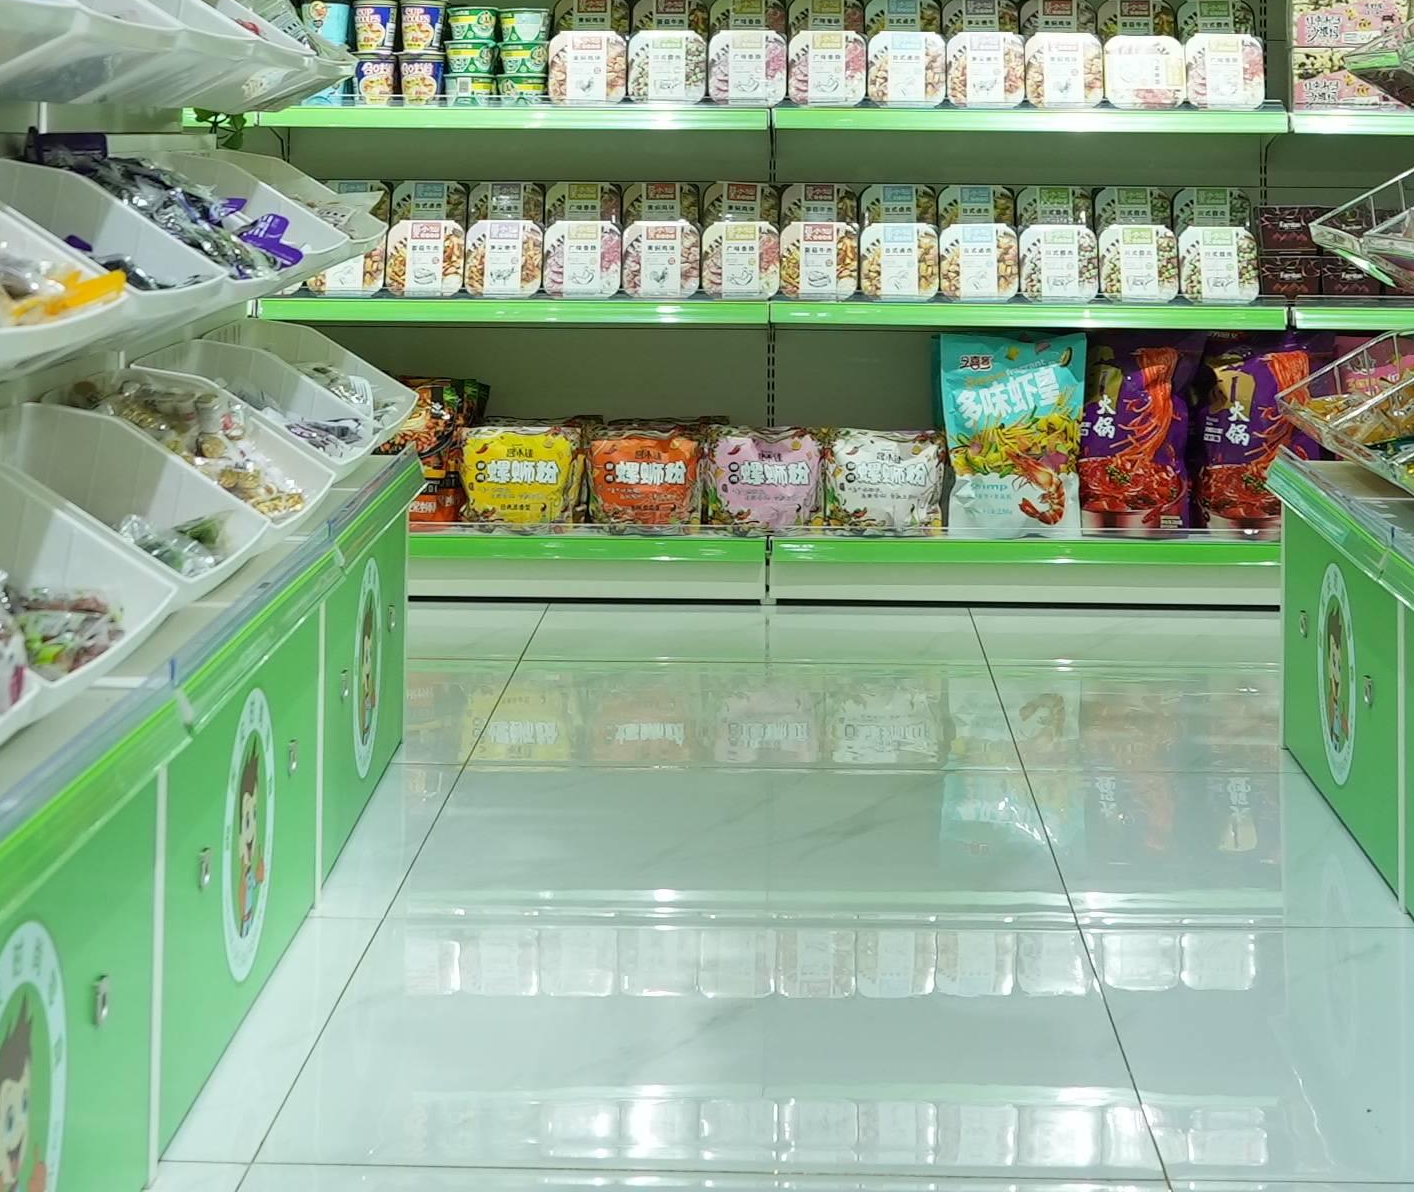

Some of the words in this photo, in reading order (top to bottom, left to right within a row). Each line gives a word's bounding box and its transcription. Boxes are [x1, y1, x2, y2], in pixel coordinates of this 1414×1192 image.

[1094, 396, 1117, 439] 火锅
[1225, 401, 1252, 447] 火锅
[488, 460, 559, 484] 螺蛳粉
[616, 460, 686, 485] 螺蛳粉
[740, 460, 811, 486] 螺蛳粉
[857, 462, 929, 486] 螺蛳粉
